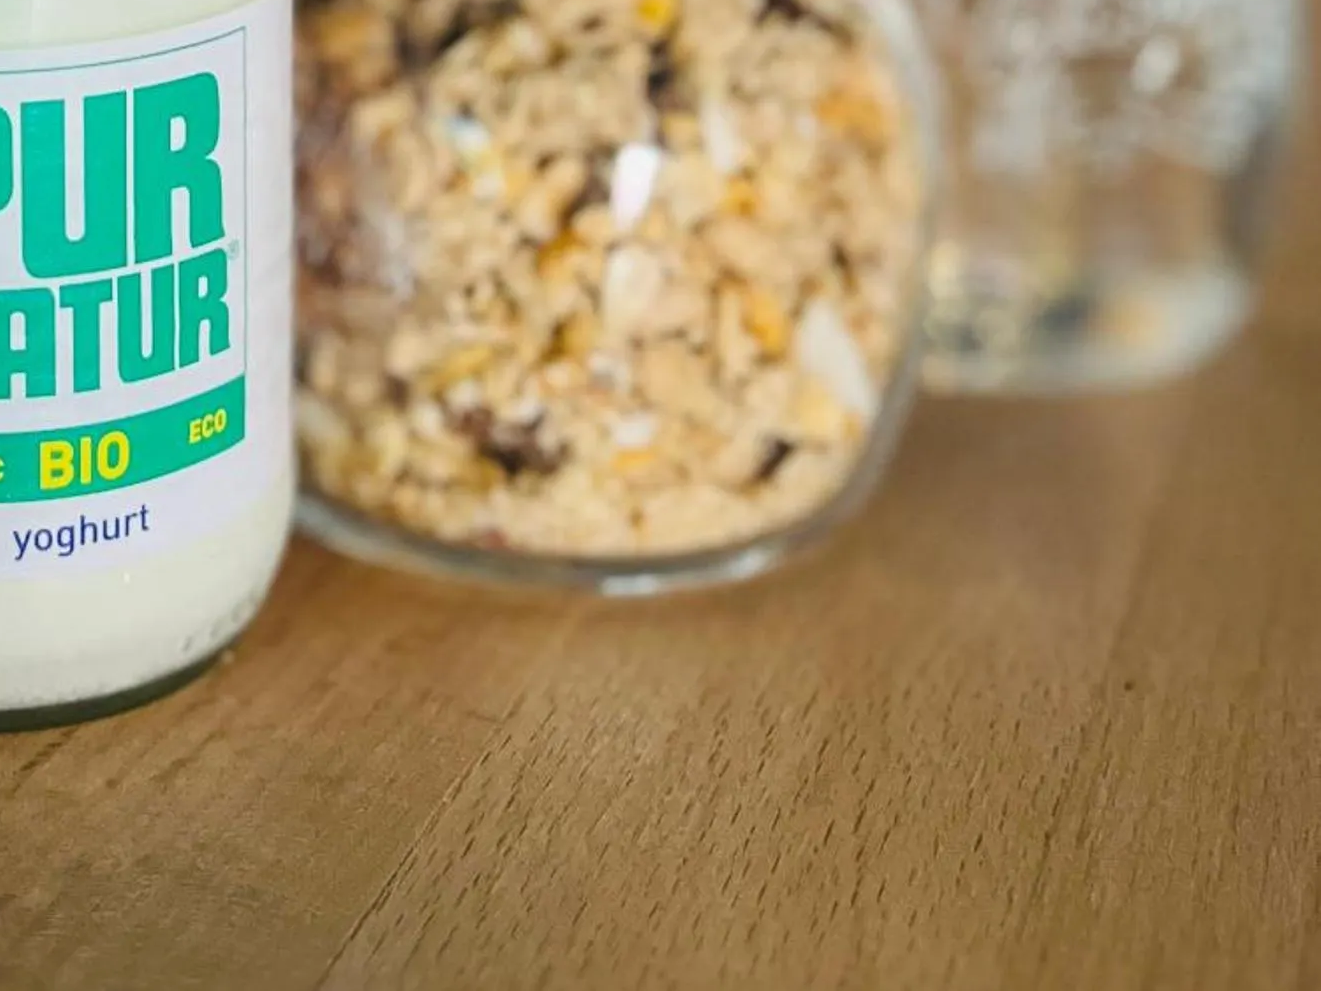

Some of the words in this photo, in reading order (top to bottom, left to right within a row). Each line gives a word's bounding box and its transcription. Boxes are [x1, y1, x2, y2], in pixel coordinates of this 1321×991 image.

[39, 430, 130, 490] BIO
[189, 408, 227, 444] ECO
[13, 504, 150, 561] yoghurt
